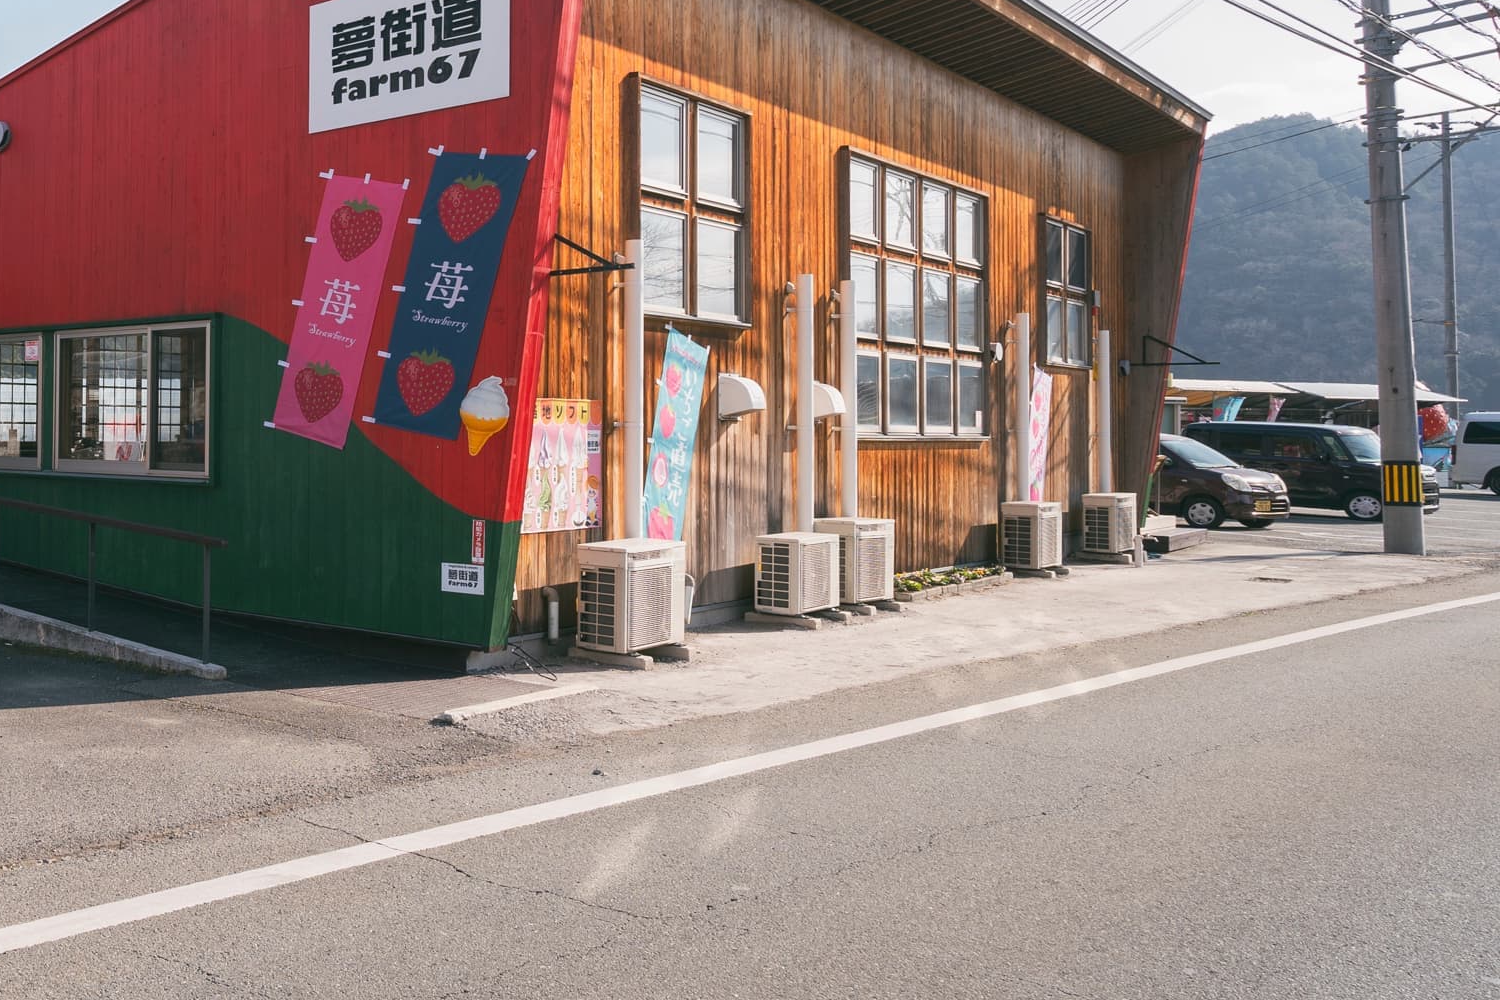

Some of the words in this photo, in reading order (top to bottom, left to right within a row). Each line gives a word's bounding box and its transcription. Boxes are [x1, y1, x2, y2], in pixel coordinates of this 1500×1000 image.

[331, 47, 482, 105] farm67
[319, 278, 361, 325] 苺
[424, 260, 474, 309] 苺
[308, 322, 357, 349] Strawberry
[411, 308, 469, 334] Strawberry
[448, 580, 479, 588] farm67
